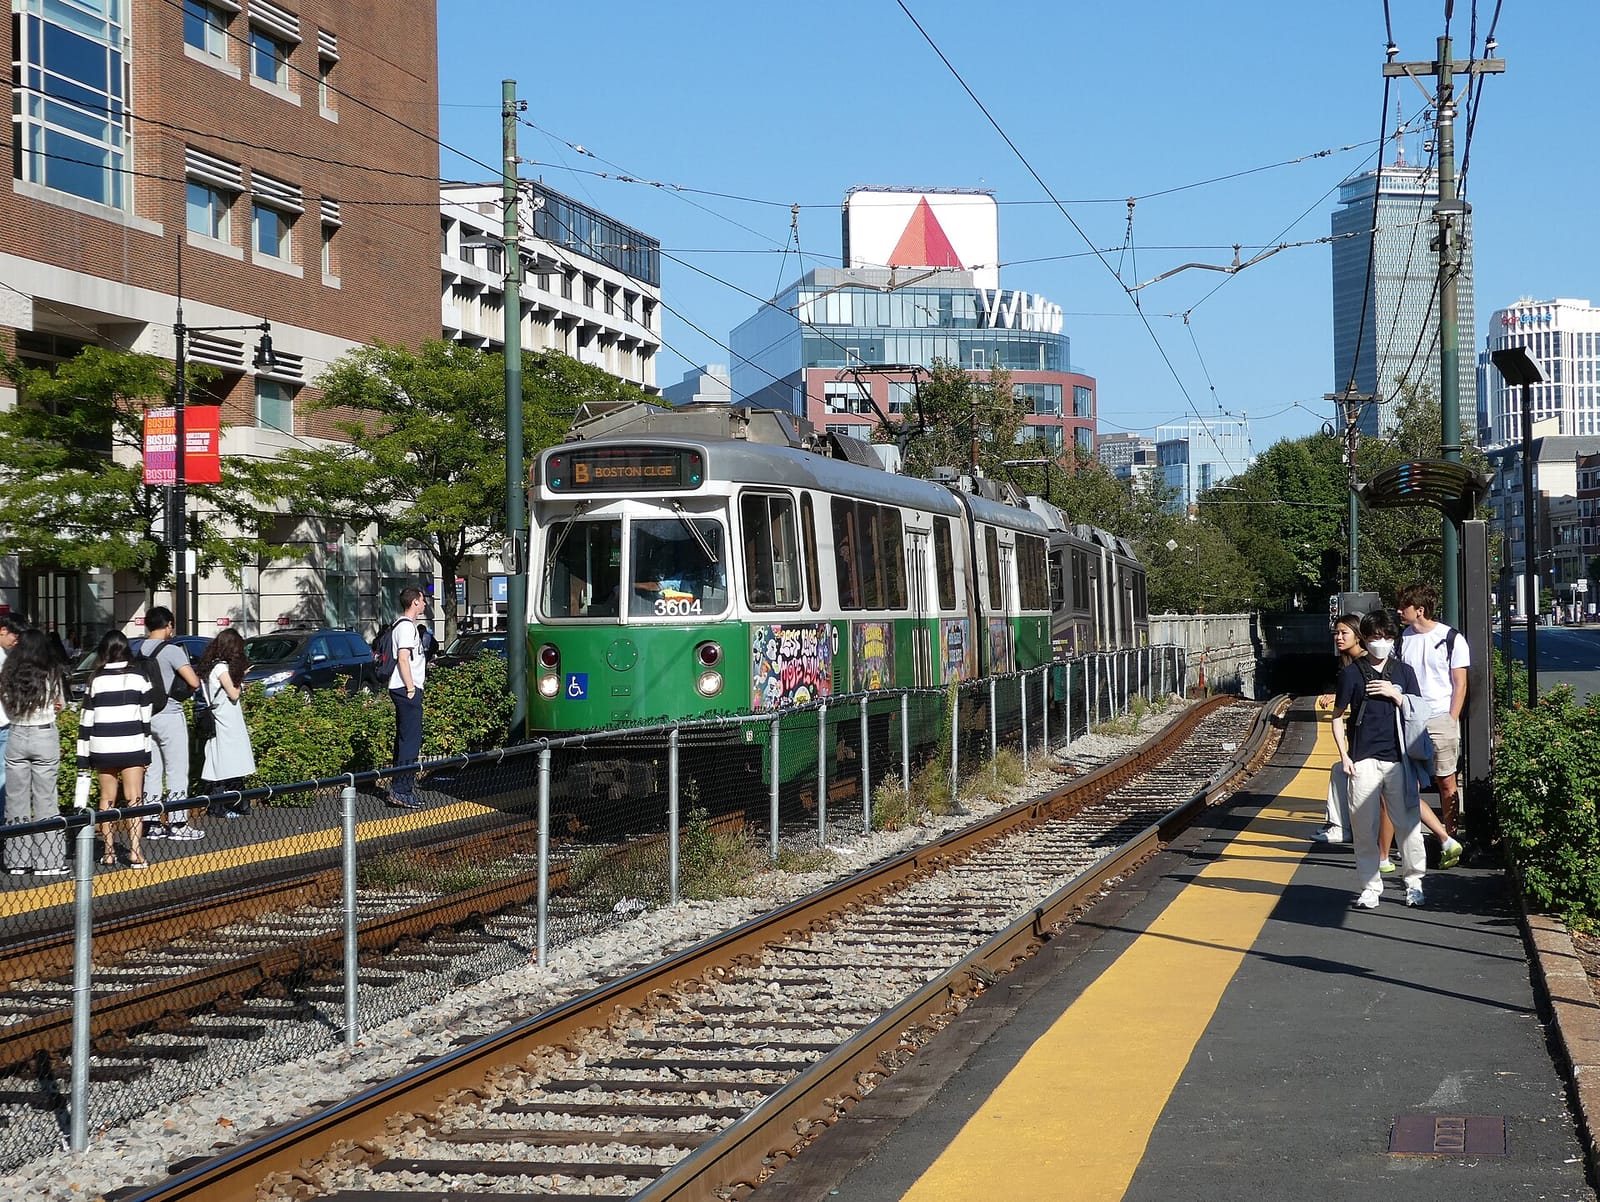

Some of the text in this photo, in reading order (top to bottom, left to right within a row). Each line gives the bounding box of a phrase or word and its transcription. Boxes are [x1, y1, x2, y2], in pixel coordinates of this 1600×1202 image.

[575, 463, 672, 484] B BOSTON CLGE
[654, 598, 703, 616] 3604
